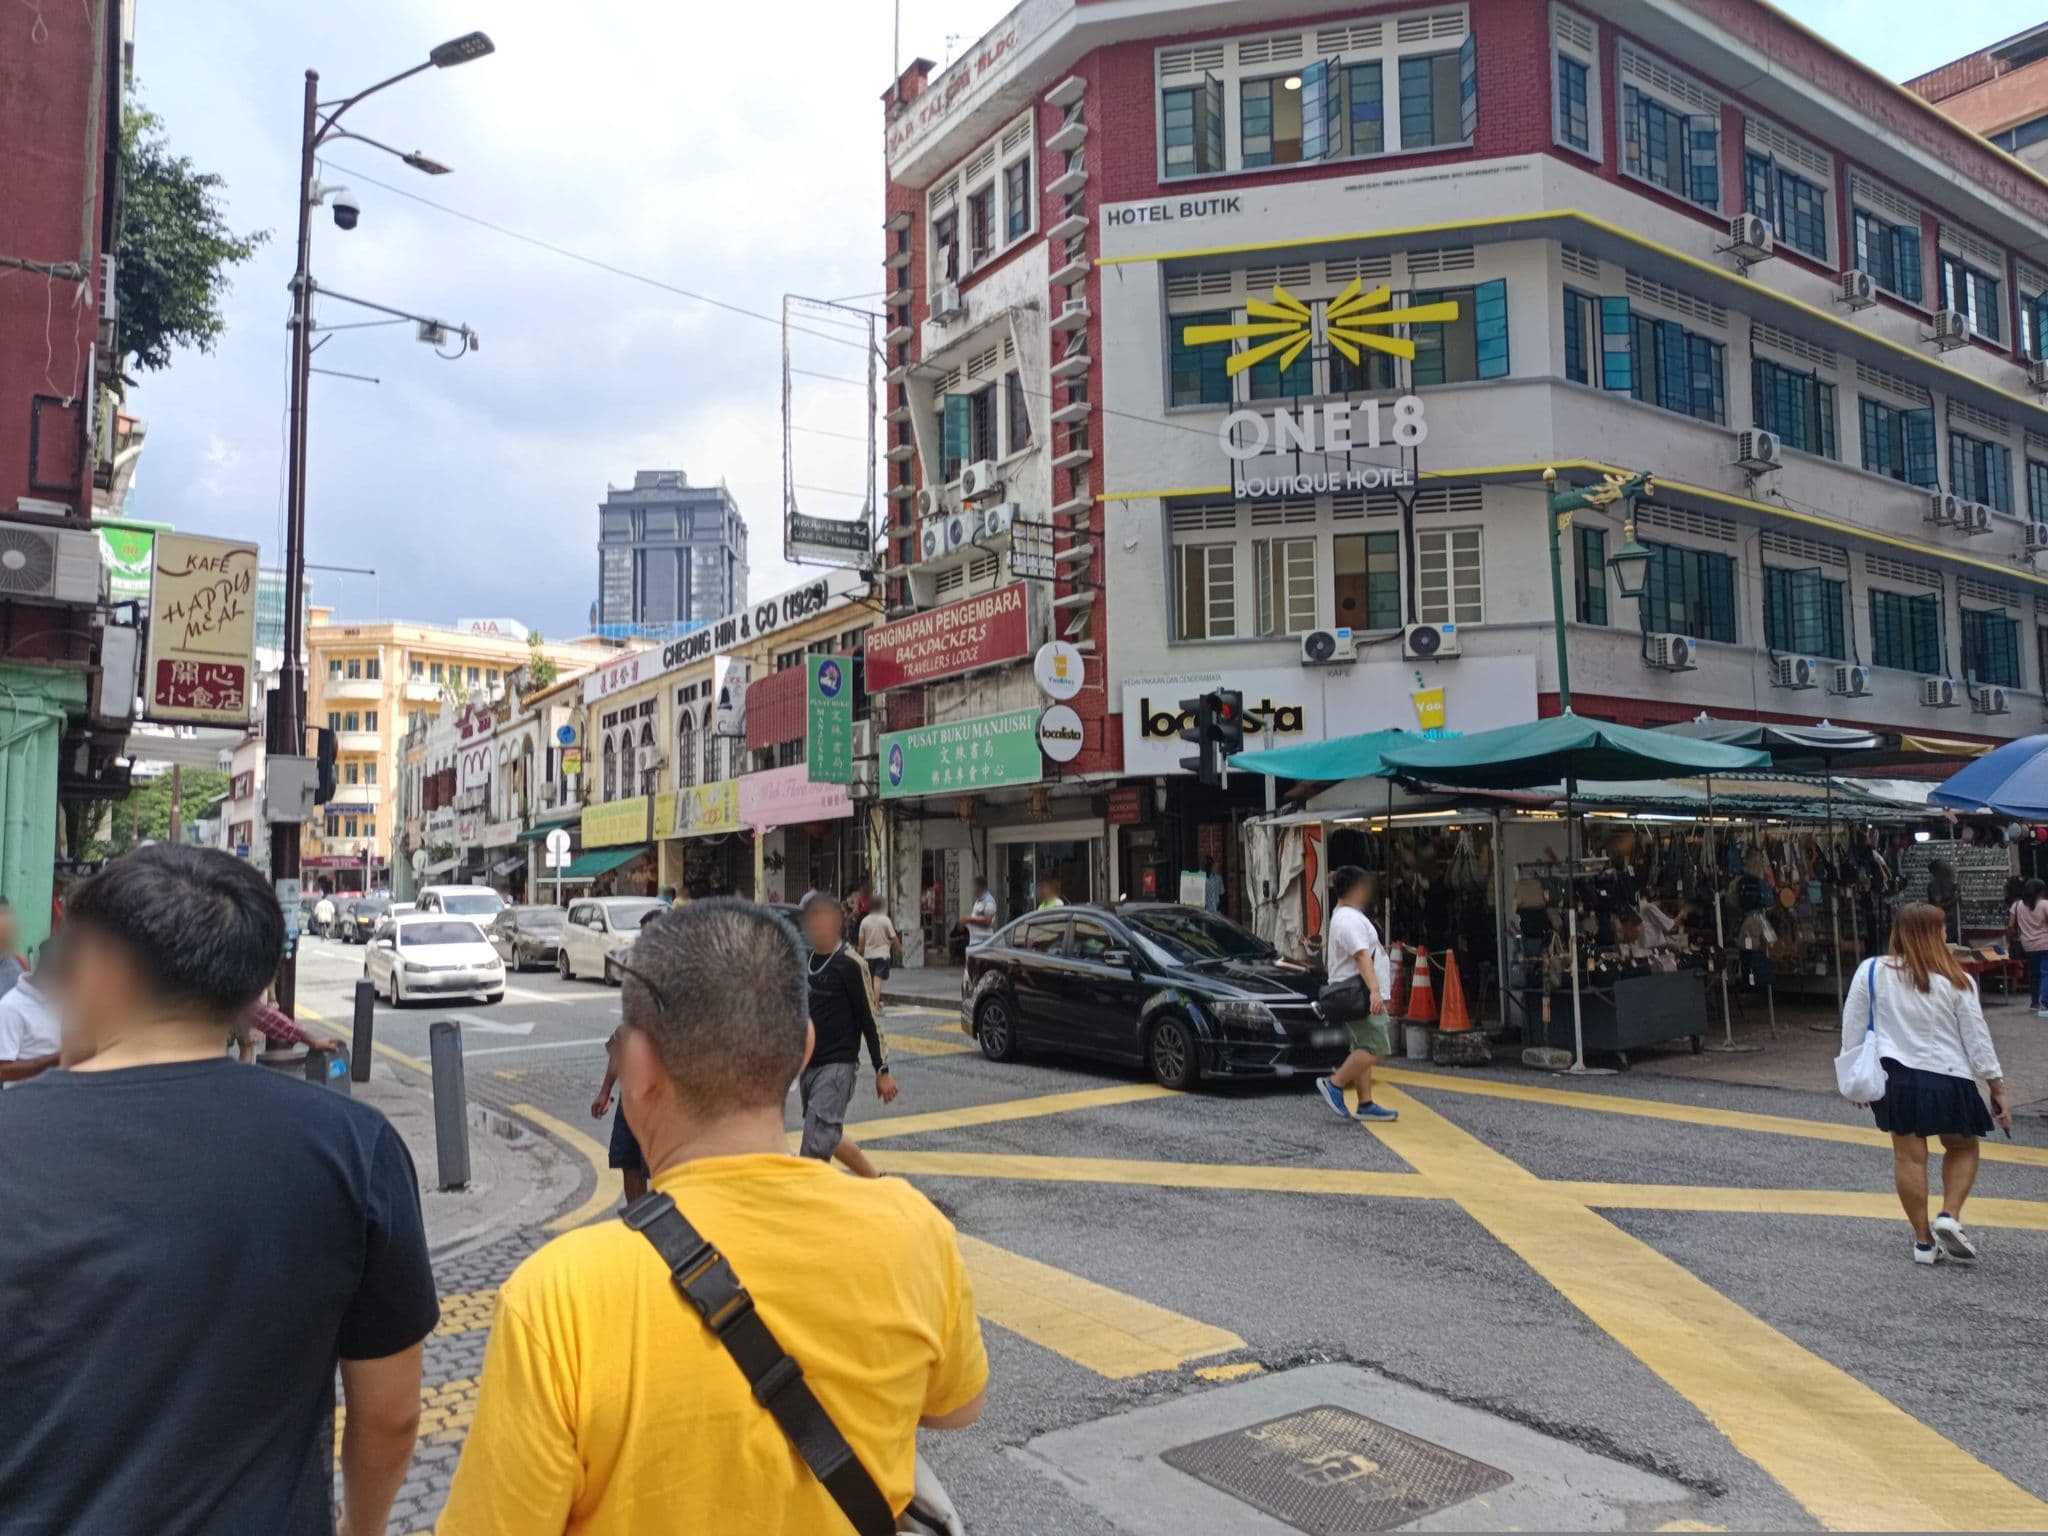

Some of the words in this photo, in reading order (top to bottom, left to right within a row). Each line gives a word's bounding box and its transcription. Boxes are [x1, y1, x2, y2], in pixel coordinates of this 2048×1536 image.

[1108, 205, 1174, 226] HOTEL
[1180, 196, 1241, 218] BUTIK
[1219, 394, 1428, 460] ONE18
[1235, 472, 1341, 499] BOUTIQUE
[1347, 468, 1414, 490] HOTEL
[186, 554, 231, 574] KAFE
[162, 568, 251, 625] HAPPY
[182, 599, 245, 650] MEAL
[471, 621, 499, 633] AIA
[663, 630, 711, 669] CHEONG
[715, 619, 736, 649] HIN
[740, 615, 751, 638] &
[755, 602, 778, 634] CO
[867, 616, 933, 654] PENGINAPAN
[936, 588, 1022, 635] PENGEMBARA
[895, 623, 988, 665] BACKPACKERS
[171, 661, 236, 687] 開心
[903, 654, 950, 679] TRAVELLERS
[157, 684, 243, 711] 小食店
[907, 730, 938, 750] PUSAT
[940, 725, 971, 745] BUKU
[972, 714, 1032, 738] MANJUSRI
[1042, 725, 1081, 741] localista
